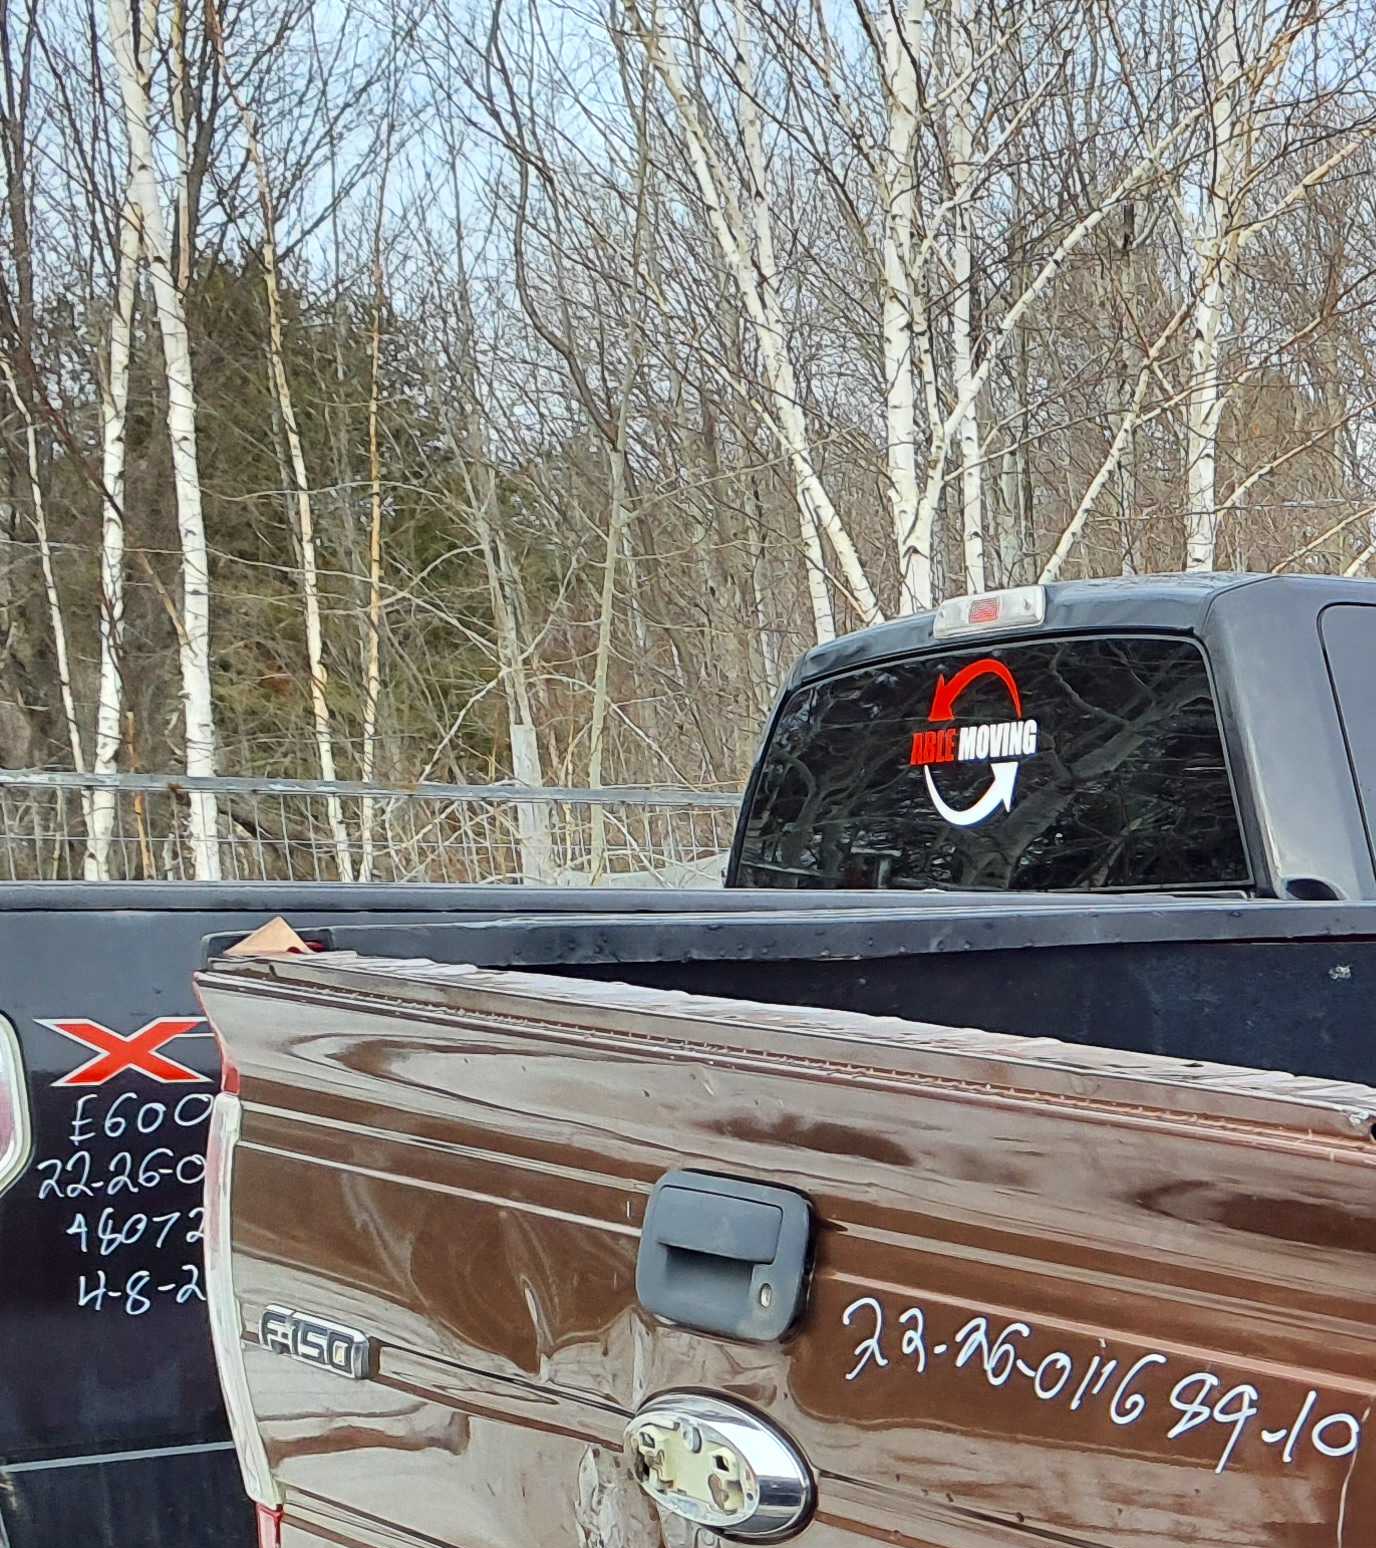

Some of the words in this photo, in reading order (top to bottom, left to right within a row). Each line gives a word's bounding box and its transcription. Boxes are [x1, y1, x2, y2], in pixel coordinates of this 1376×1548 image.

[909, 727, 957, 766] ABLE
[957, 718, 1038, 762] MOVING
[32, 1015, 216, 1087] X
[69, 1091, 214, 1145] E600
[842, 1296, 1361, 1473] 22-26-011689-10
